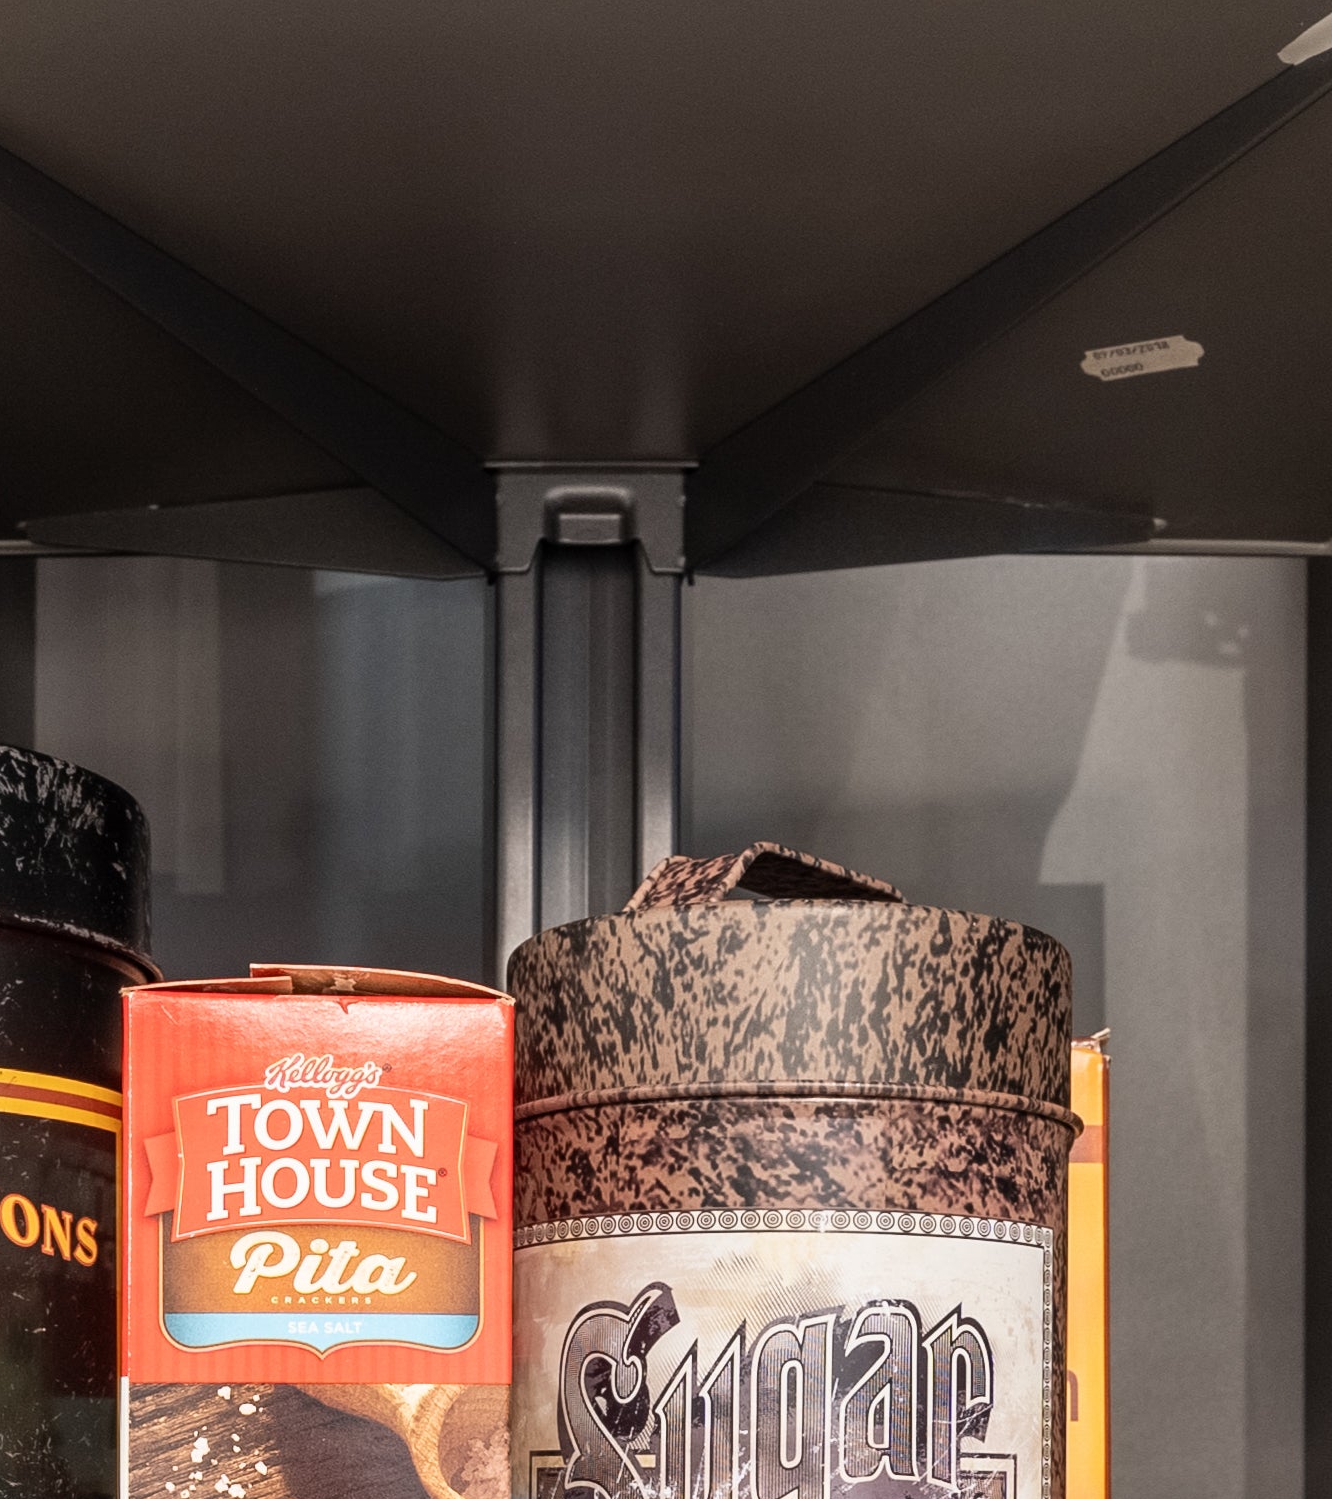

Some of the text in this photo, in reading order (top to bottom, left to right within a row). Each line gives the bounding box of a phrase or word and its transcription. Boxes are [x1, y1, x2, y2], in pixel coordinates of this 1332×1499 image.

[264, 1052, 382, 1097] Kellogg's
[206, 1093, 429, 1158] TOWN
[206, 1156, 438, 1224] HOUSE
[229, 1230, 417, 1296] Pita
[270, 1295, 373, 1305] CRACKERS
[288, 1321, 363, 1334] SEA SALT
